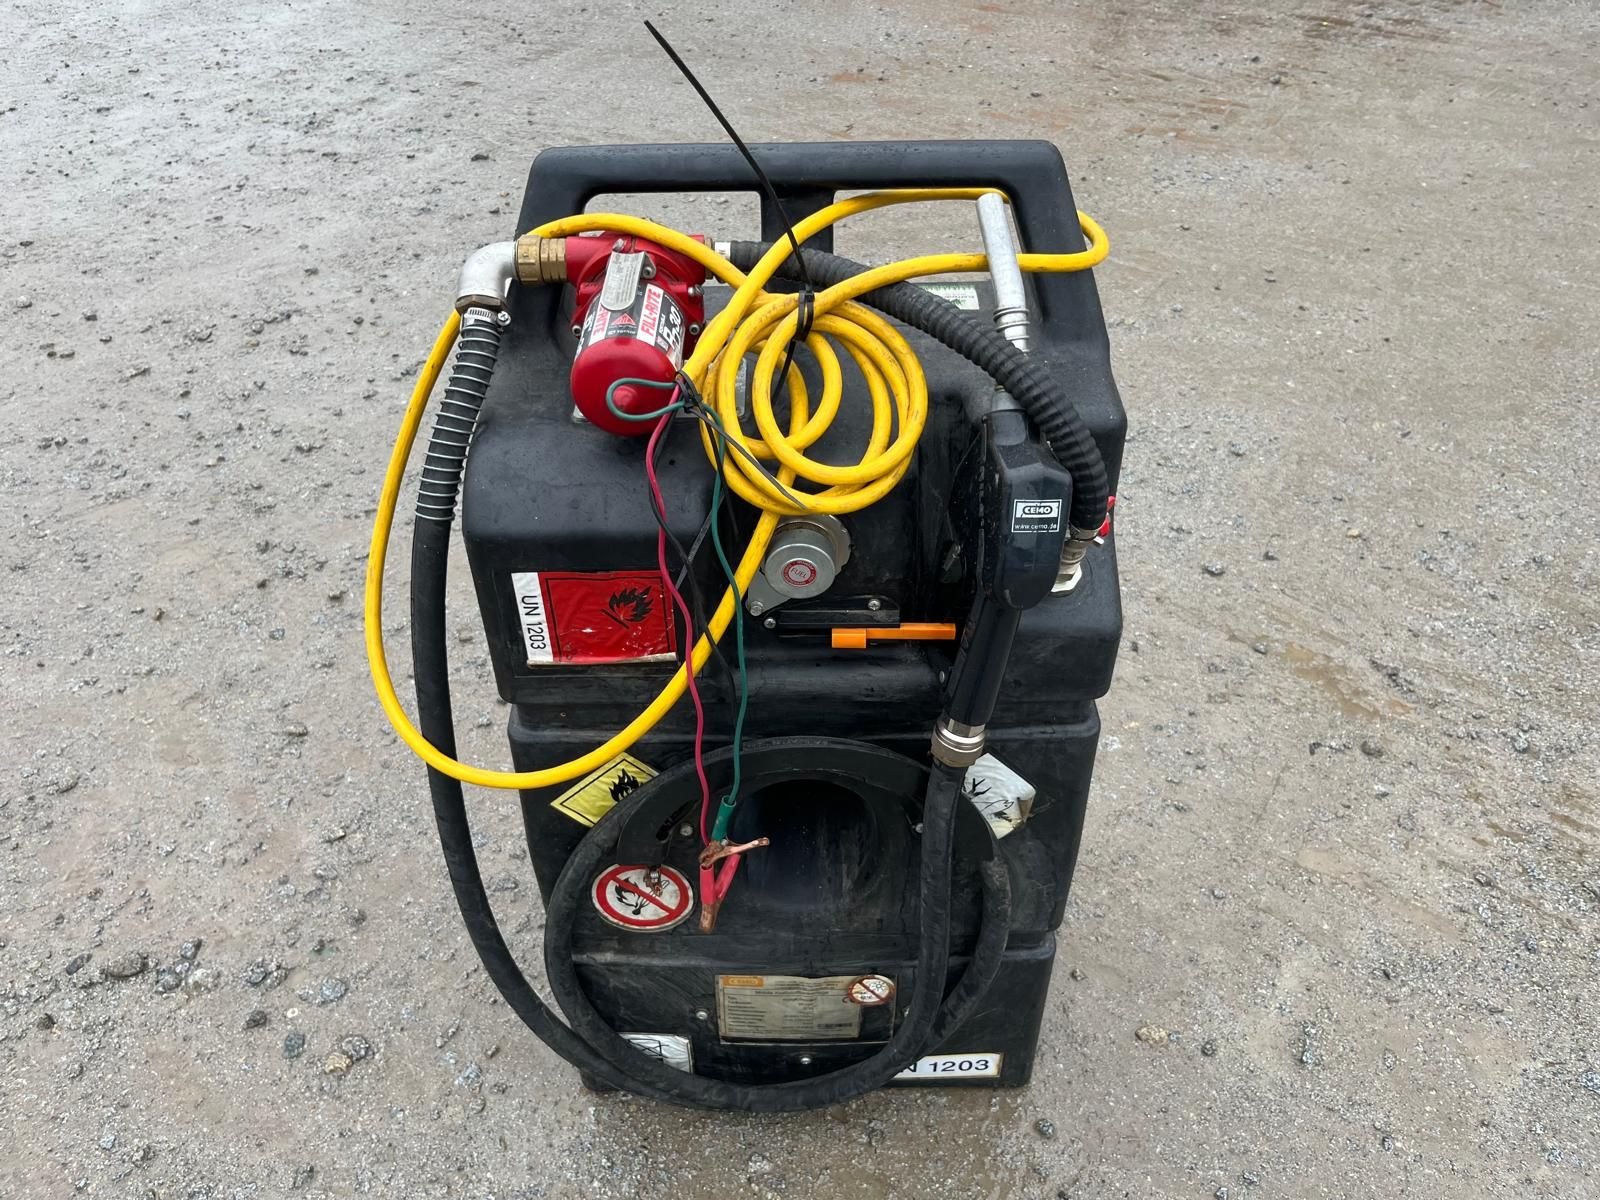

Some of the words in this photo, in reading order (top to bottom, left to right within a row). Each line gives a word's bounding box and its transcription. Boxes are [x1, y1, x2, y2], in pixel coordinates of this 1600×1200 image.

[640, 288, 661, 337] FILL-RITE
[1023, 506, 1052, 514] CEMO
[521, 595, 539, 616] UN
[526, 622, 546, 650] 1203
[929, 1059, 990, 1073] 1203
